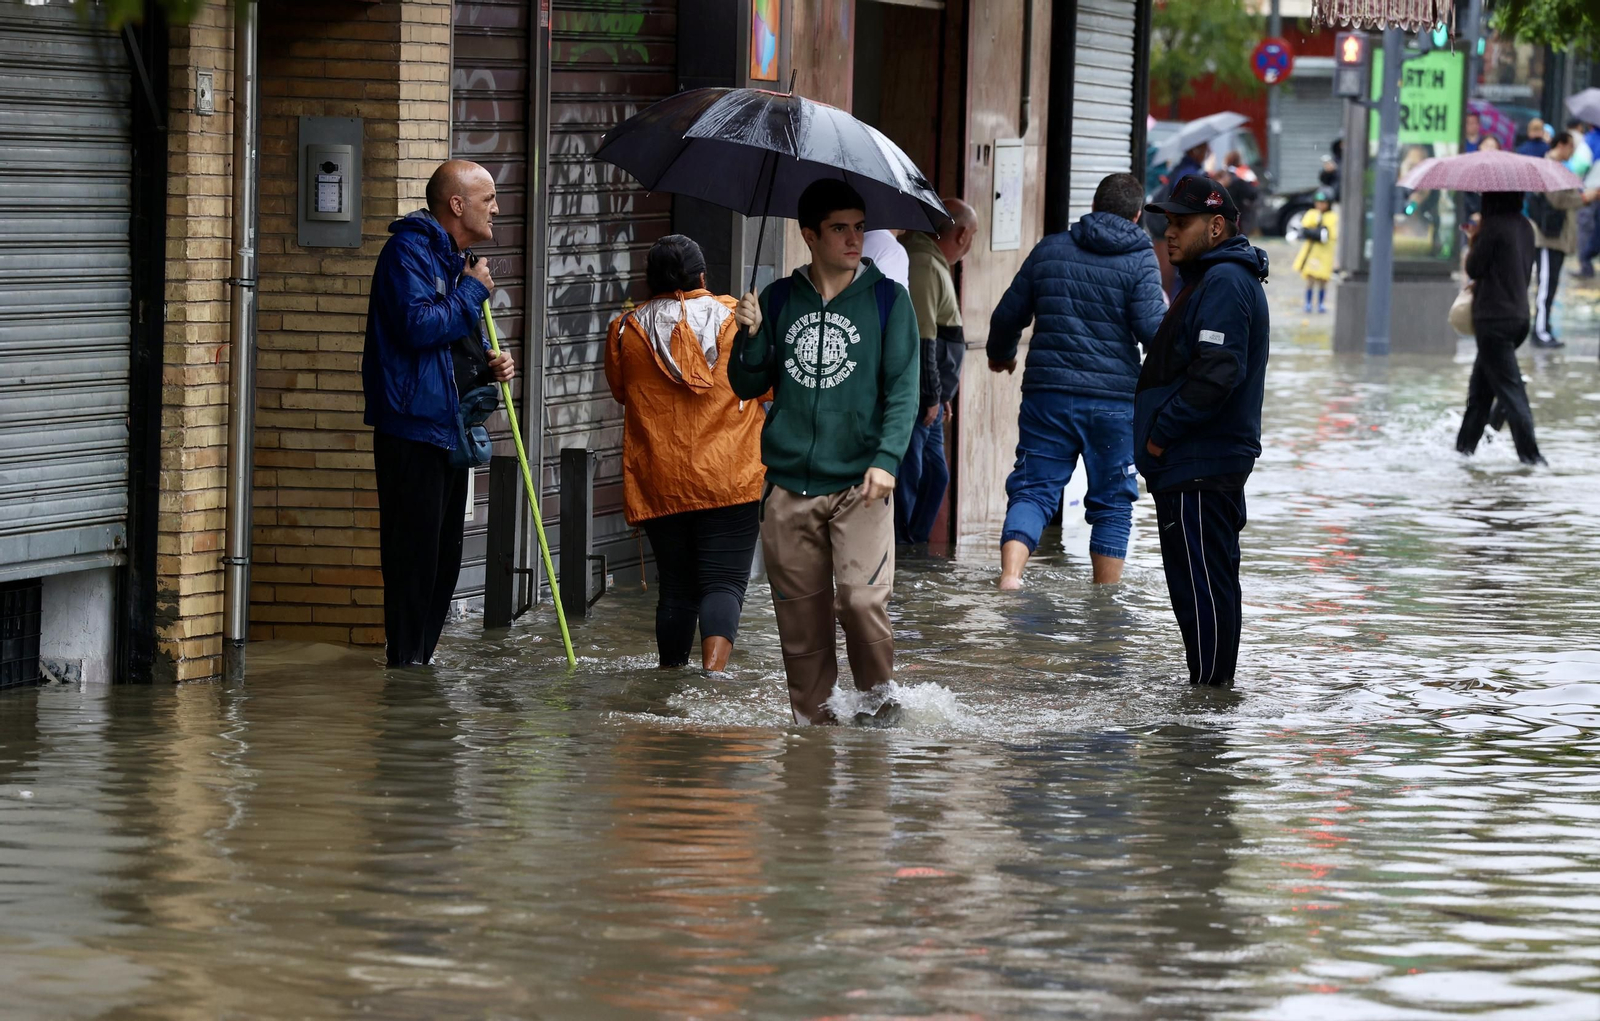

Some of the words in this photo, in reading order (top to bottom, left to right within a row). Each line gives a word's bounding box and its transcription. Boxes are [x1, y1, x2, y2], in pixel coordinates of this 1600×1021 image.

[1404, 68, 1444, 88] ATCH
[1400, 104, 1447, 131] RUSH
[785, 311, 861, 345] UNIVERSIDAD
[784, 358, 857, 389] SALAMANCA
